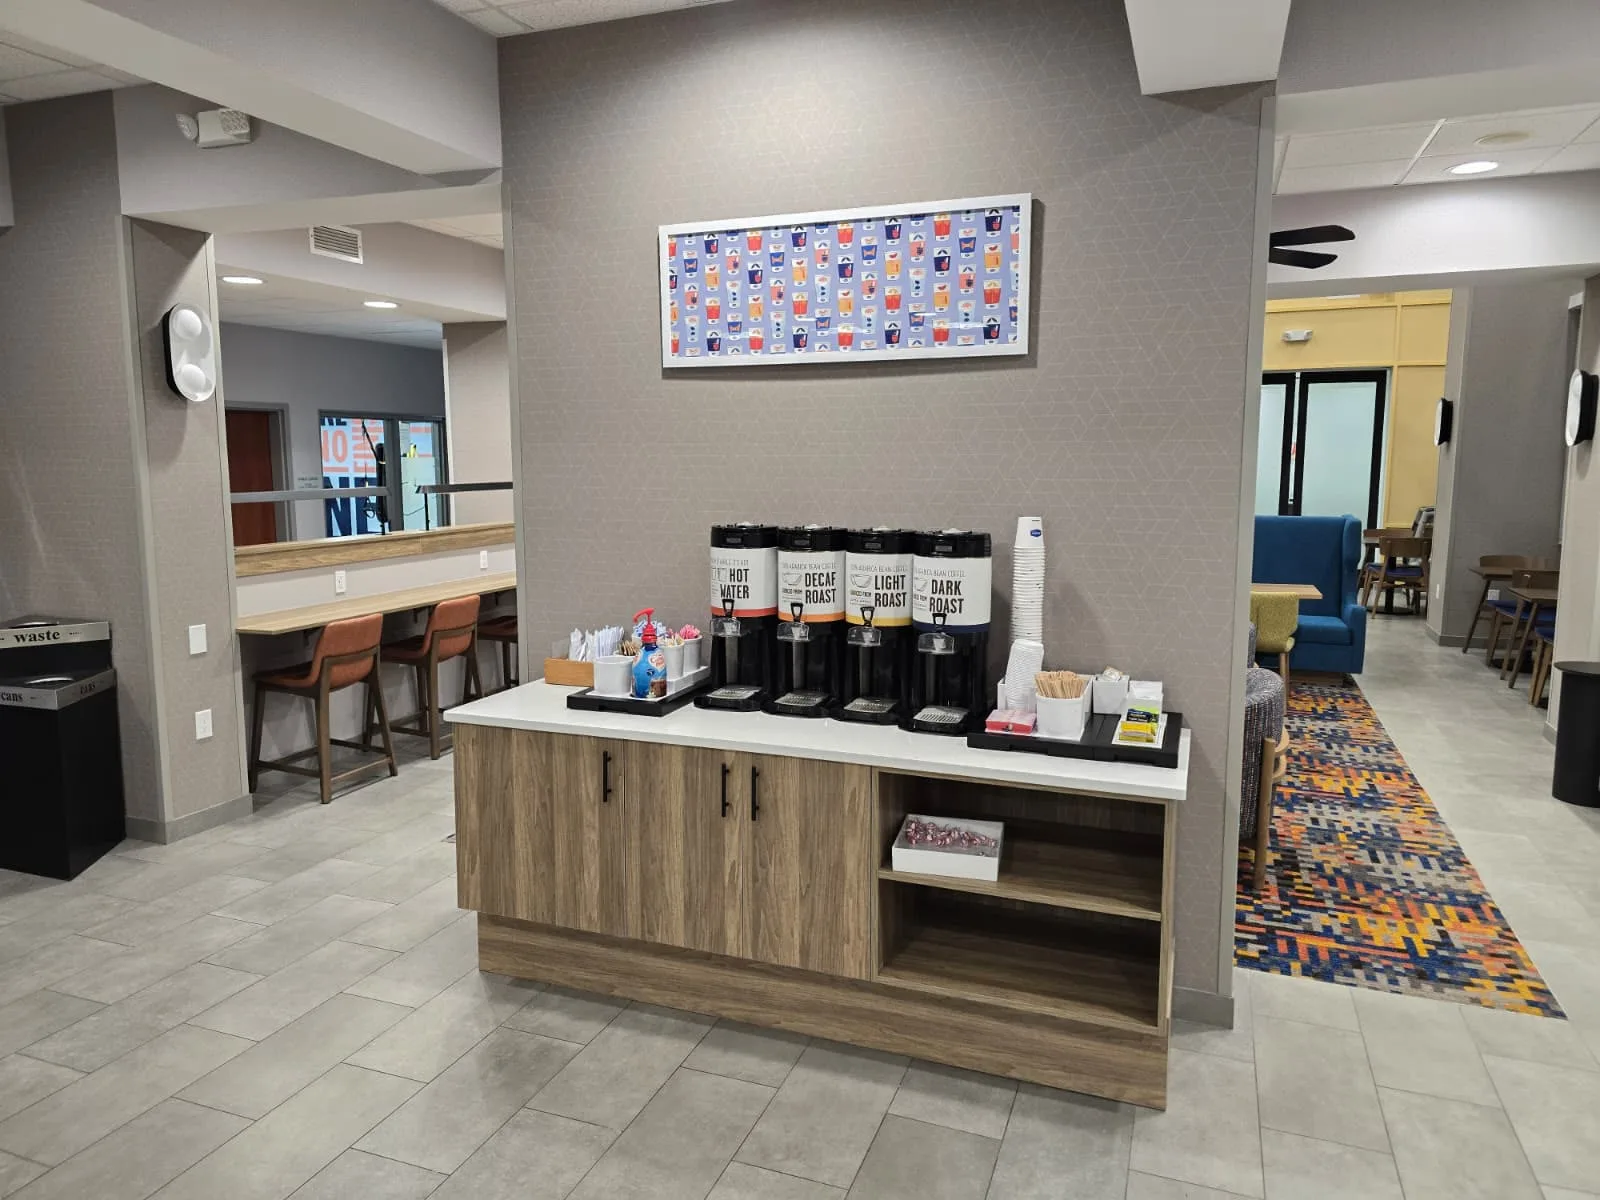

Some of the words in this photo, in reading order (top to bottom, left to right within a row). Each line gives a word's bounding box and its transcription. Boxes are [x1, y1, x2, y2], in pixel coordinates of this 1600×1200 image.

[729, 568, 750, 583] HOT
[804, 572, 837, 587] DECAF
[874, 574, 906, 591] LIGHT
[720, 583, 750, 600] WATER
[931, 579, 962, 596] DARK
[805, 588, 837, 605] ROAST
[874, 591, 907, 608] ROAST
[929, 597, 965, 614] ROAST
[14, 629, 60, 644] waste
